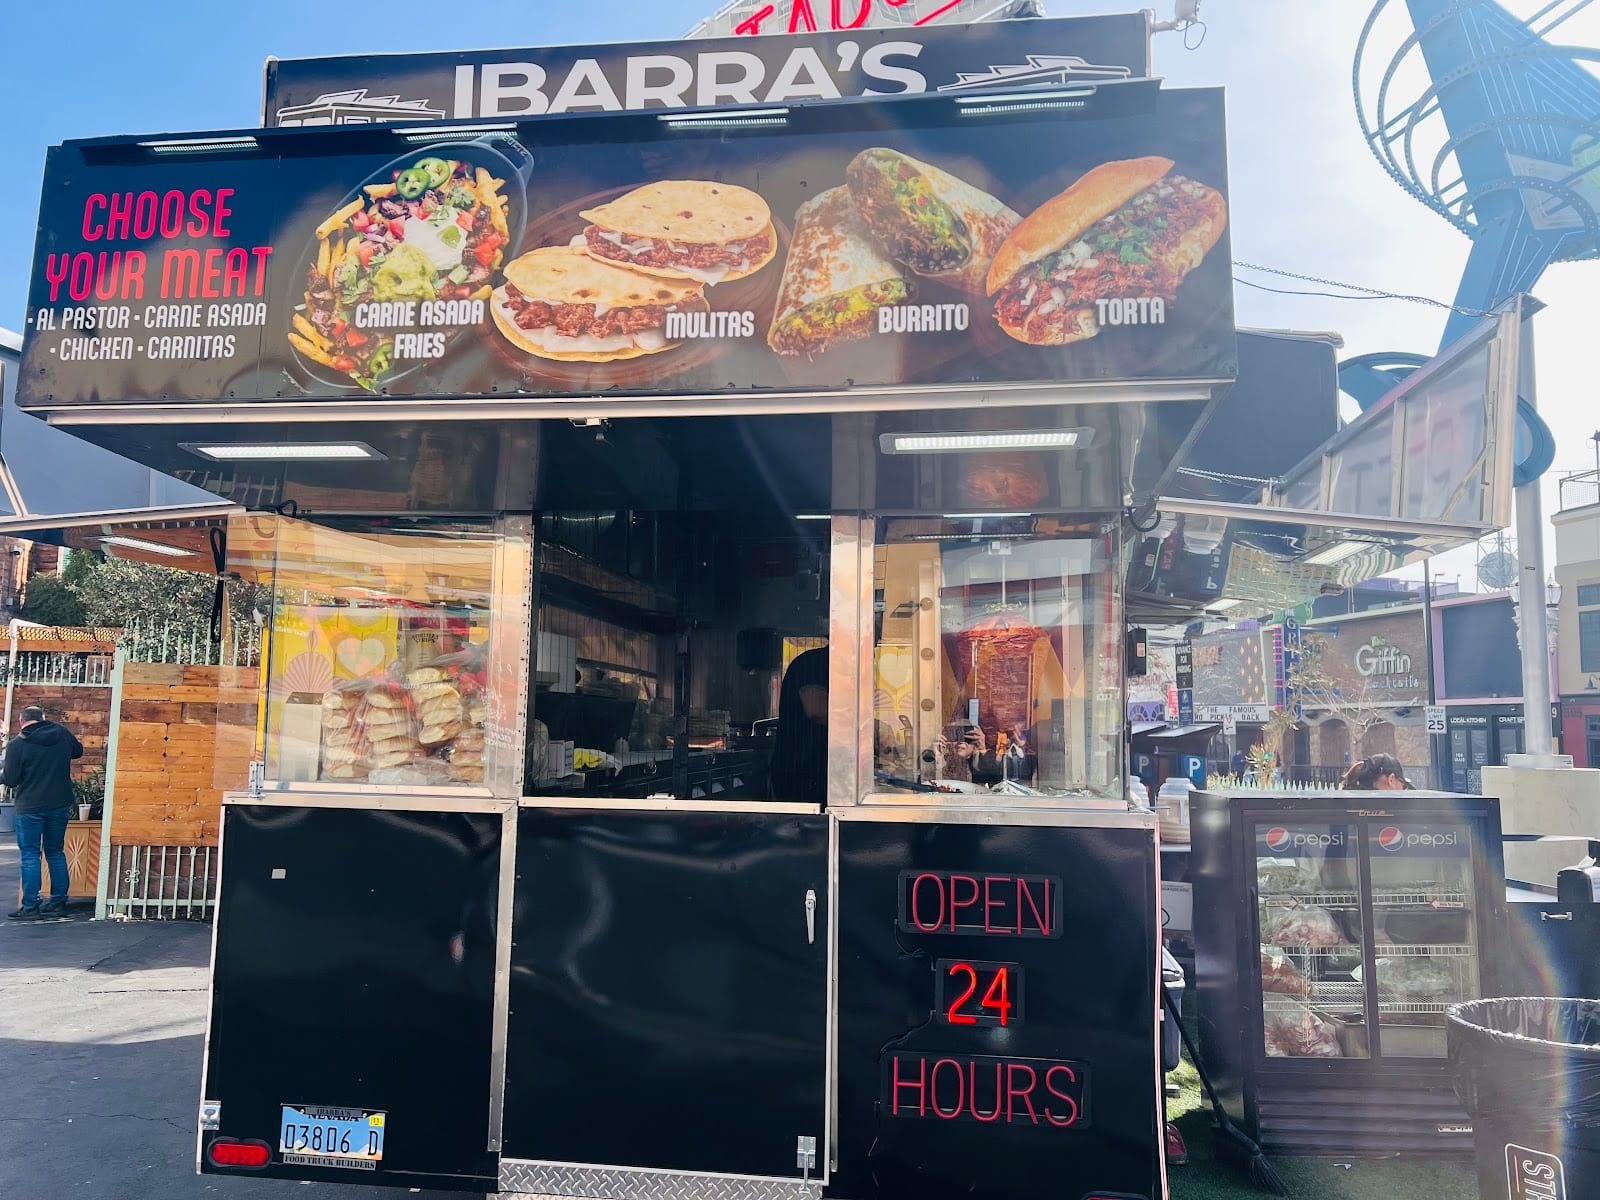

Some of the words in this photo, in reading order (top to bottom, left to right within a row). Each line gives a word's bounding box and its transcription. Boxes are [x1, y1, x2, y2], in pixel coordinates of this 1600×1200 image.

[453, 41, 927, 119] IBARRA'S
[82, 188, 235, 242] CHOOSE
[46, 250, 145, 302] YOUR
[161, 246, 273, 299] MEAT
[36, 307, 55, 331] AL
[61, 305, 130, 330] PASTOR
[144, 304, 202, 328] CARNE
[206, 302, 267, 327] ASADA
[355, 301, 416, 328] CARNE
[419, 300, 484, 327] ASADA
[665, 310, 755, 340] MULITAS
[878, 303, 969, 334] BURRITO
[1095, 296, 1166, 326] TORTA
[59, 337, 134, 361] CHICKEN
[147, 334, 235, 360] CARNITAS
[394, 332, 446, 360] FRIES
[1427, 719, 1445, 731] 25
[1189, 757, 1201, 778] P
[1294, 831, 1344, 848] pepsi
[1407, 831, 1457, 848] pepsi
[911, 873, 1051, 937] OPEN
[947, 962, 1012, 1027] 24
[892, 1055, 1079, 1127] HOURS
[285, 1155, 306, 1164] FOOD
[307, 1156, 335, 1167] TRUCK
[336, 1159, 375, 1170] BUILDERS
